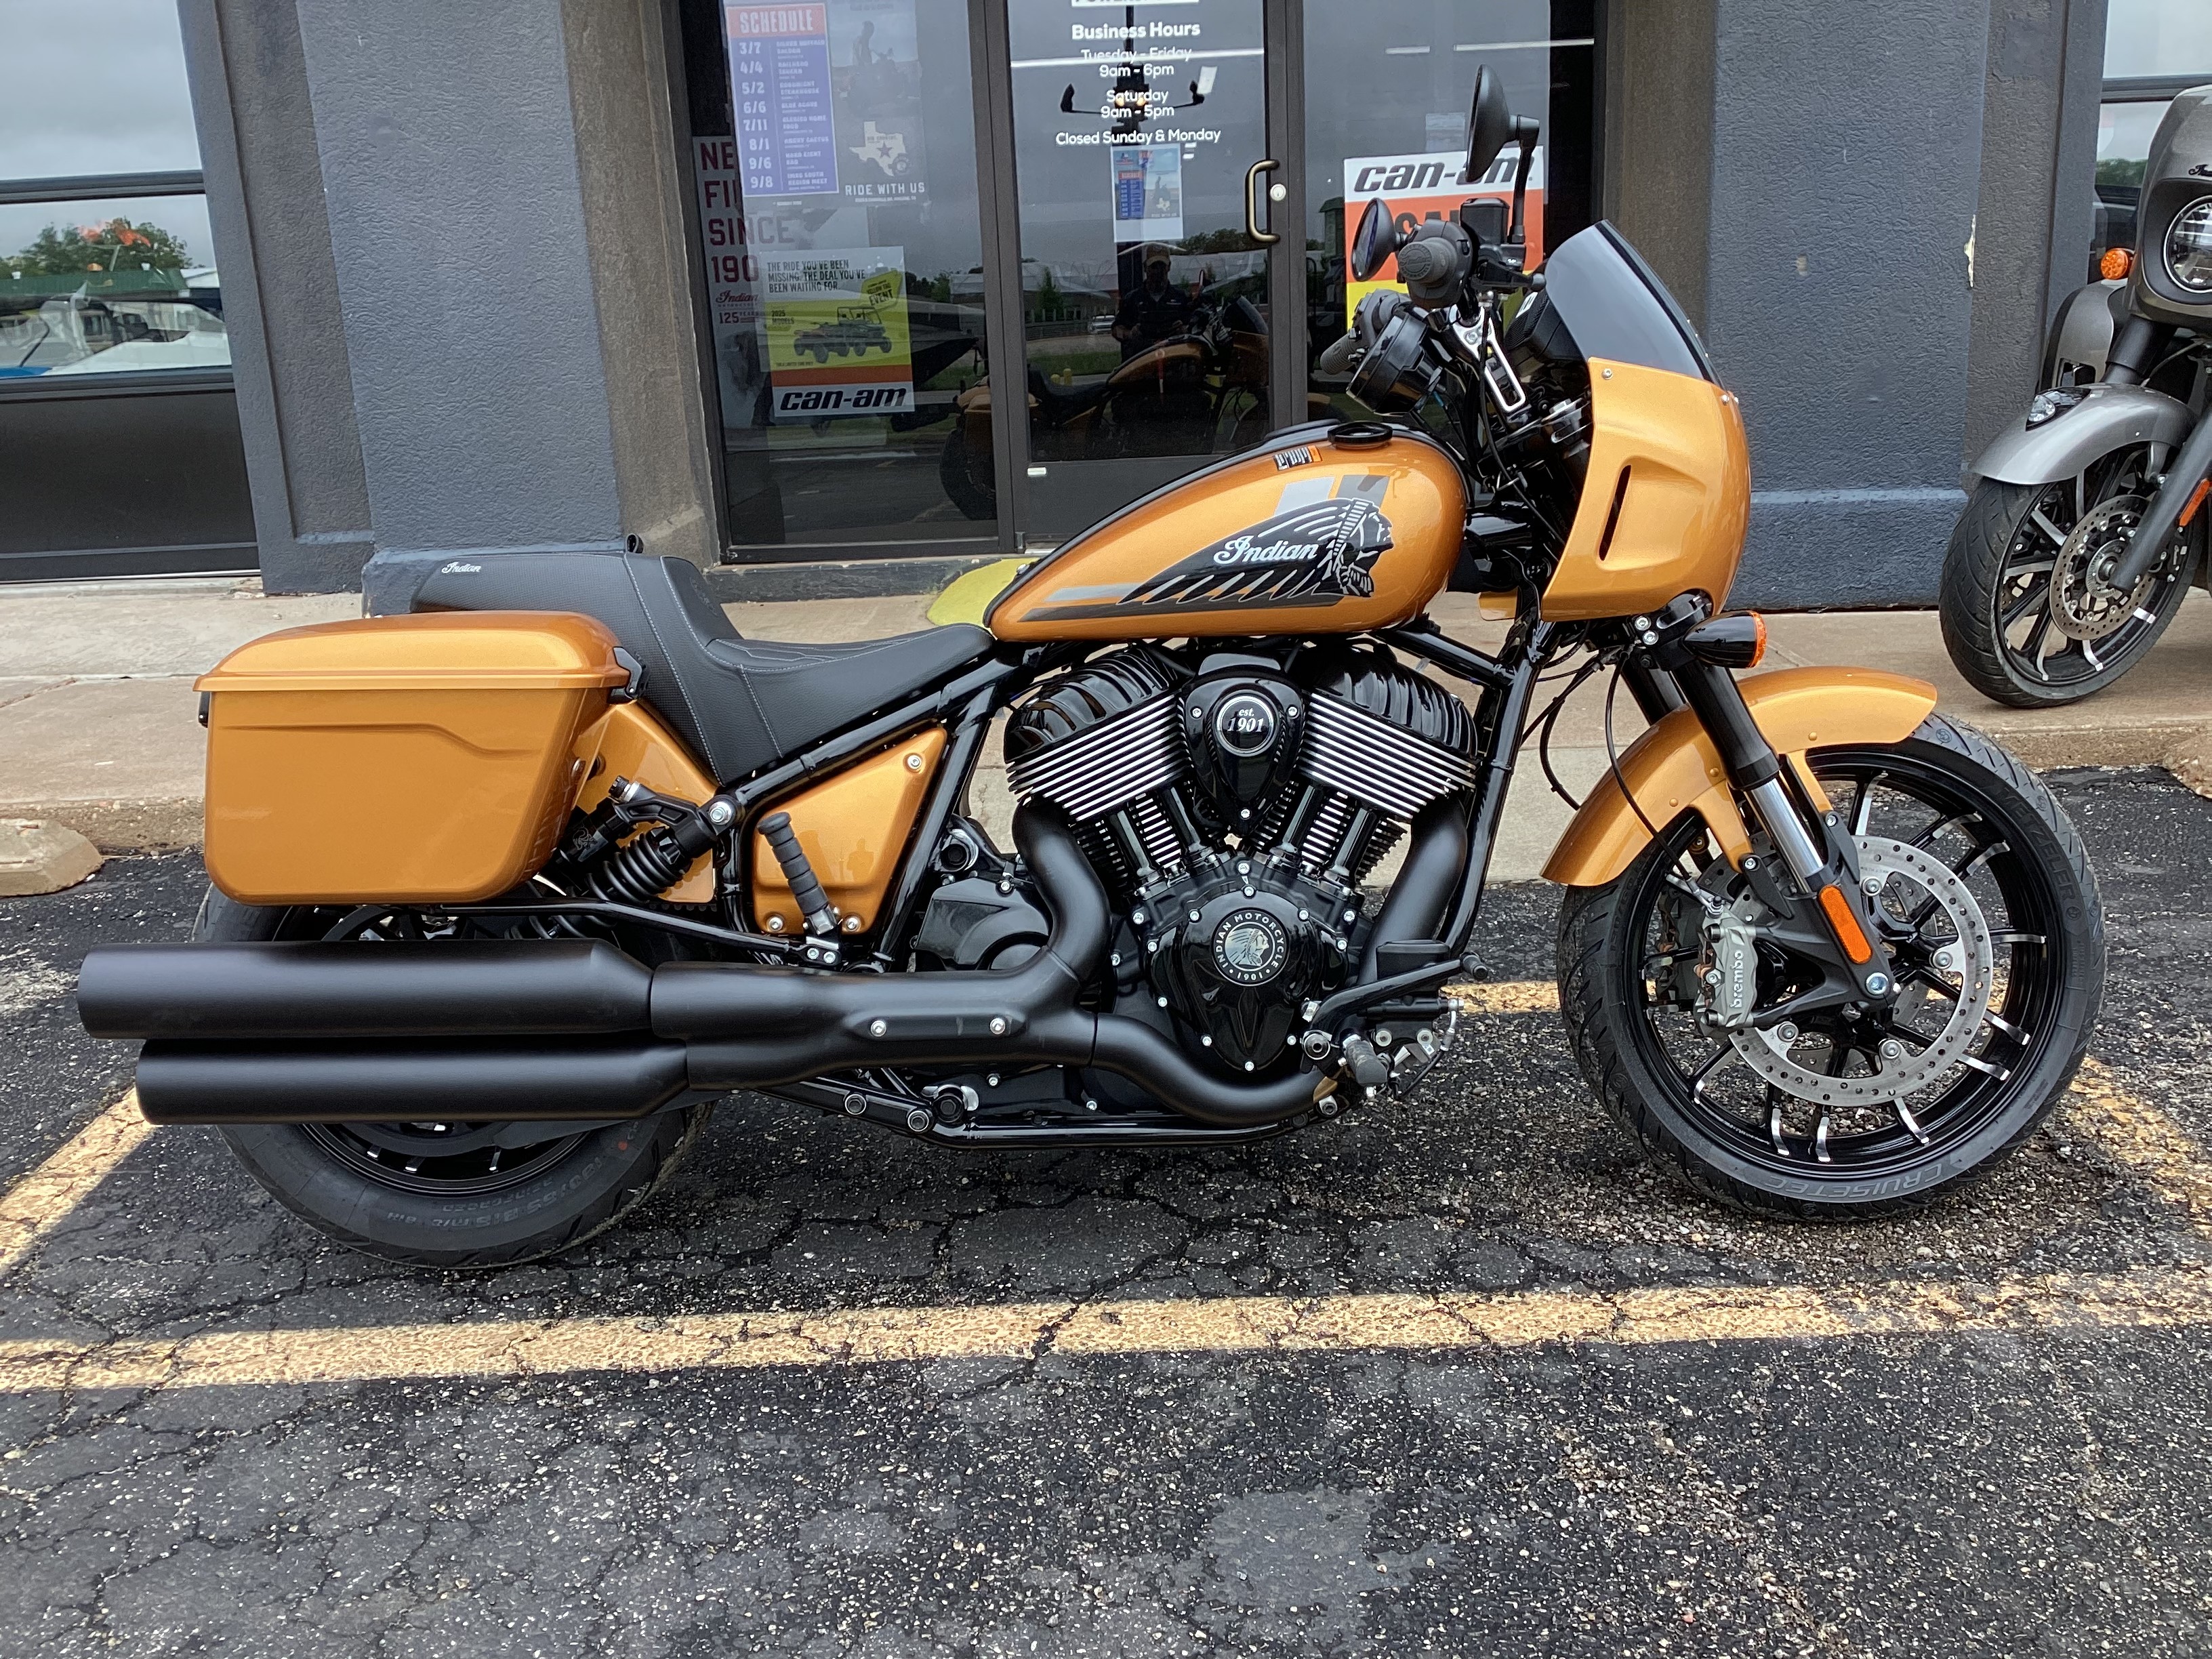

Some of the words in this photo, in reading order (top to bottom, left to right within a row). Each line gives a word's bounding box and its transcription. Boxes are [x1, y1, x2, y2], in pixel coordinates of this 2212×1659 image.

[739, 9, 813, 33] SCHEDULE
[1071, 22, 1146, 39] Business
[1149, 21, 1201, 37] Hours
[739, 41, 761, 55] 3/7
[1081, 48, 1137, 64] Tuesday
[1149, 47, 1192, 62] Friday
[740, 60, 763, 74] 4/4
[1099, 64, 1131, 77] 9am
[1143, 64, 1174, 79] 6pm
[741, 81, 765, 95] 5/2
[1106, 89, 1169, 104] Saturday
[743, 101, 766, 114] 6/6
[1101, 106, 1132, 119] 9am
[1144, 106, 1175, 120] 5pm
[743, 119, 768, 131] 7/11
[1056, 131, 1100, 145] Closed
[1103, 130, 1152, 146] Sunday
[1155, 129, 1166, 141] &
[1168, 127, 1221, 144] Monday
[749, 138, 770, 150] 8/1
[700, 142, 734, 170] NE
[749, 157, 772, 169] 9/6
[750, 176, 773, 188] 9/8
[845, 184, 873, 196] RIDE
[878, 183, 905, 194] WITH
[909, 182, 925, 193] US
[708, 216, 795, 246] SINCE
[767, 262, 781, 272] THE
[783, 261, 800, 271] RIDE
[802, 260, 828, 270] YOU'VE
[830, 259, 849, 270] BEEN
[803, 270, 818, 281] THE
[819, 270, 837, 281] DEAL
[840, 269, 865, 280] YOU'VE
[769, 283, 788, 293] BEEN
[790, 281, 821, 292] WAITING
[716, 289, 758, 303] Indian
[869, 289, 893, 306] EVENT
[720, 312, 739, 324] 125
[780, 388, 906, 411] can-am
[1213, 535, 1317, 564] Indian
[441, 561, 481, 573] Indian
[1239, 708, 1254, 717] est.
[1227, 718, 1264, 733] 1901
[1995, 786, 2075, 901] METZELER
[1216, 922, 1232, 968] INDIAN
[1234, 912, 1284, 968] MOTORCYCLE
[1237, 972, 1263, 981] 1901
[1729, 949, 1744, 1008] brembo
[1764, 1163, 1942, 1197] CRUISETEC
